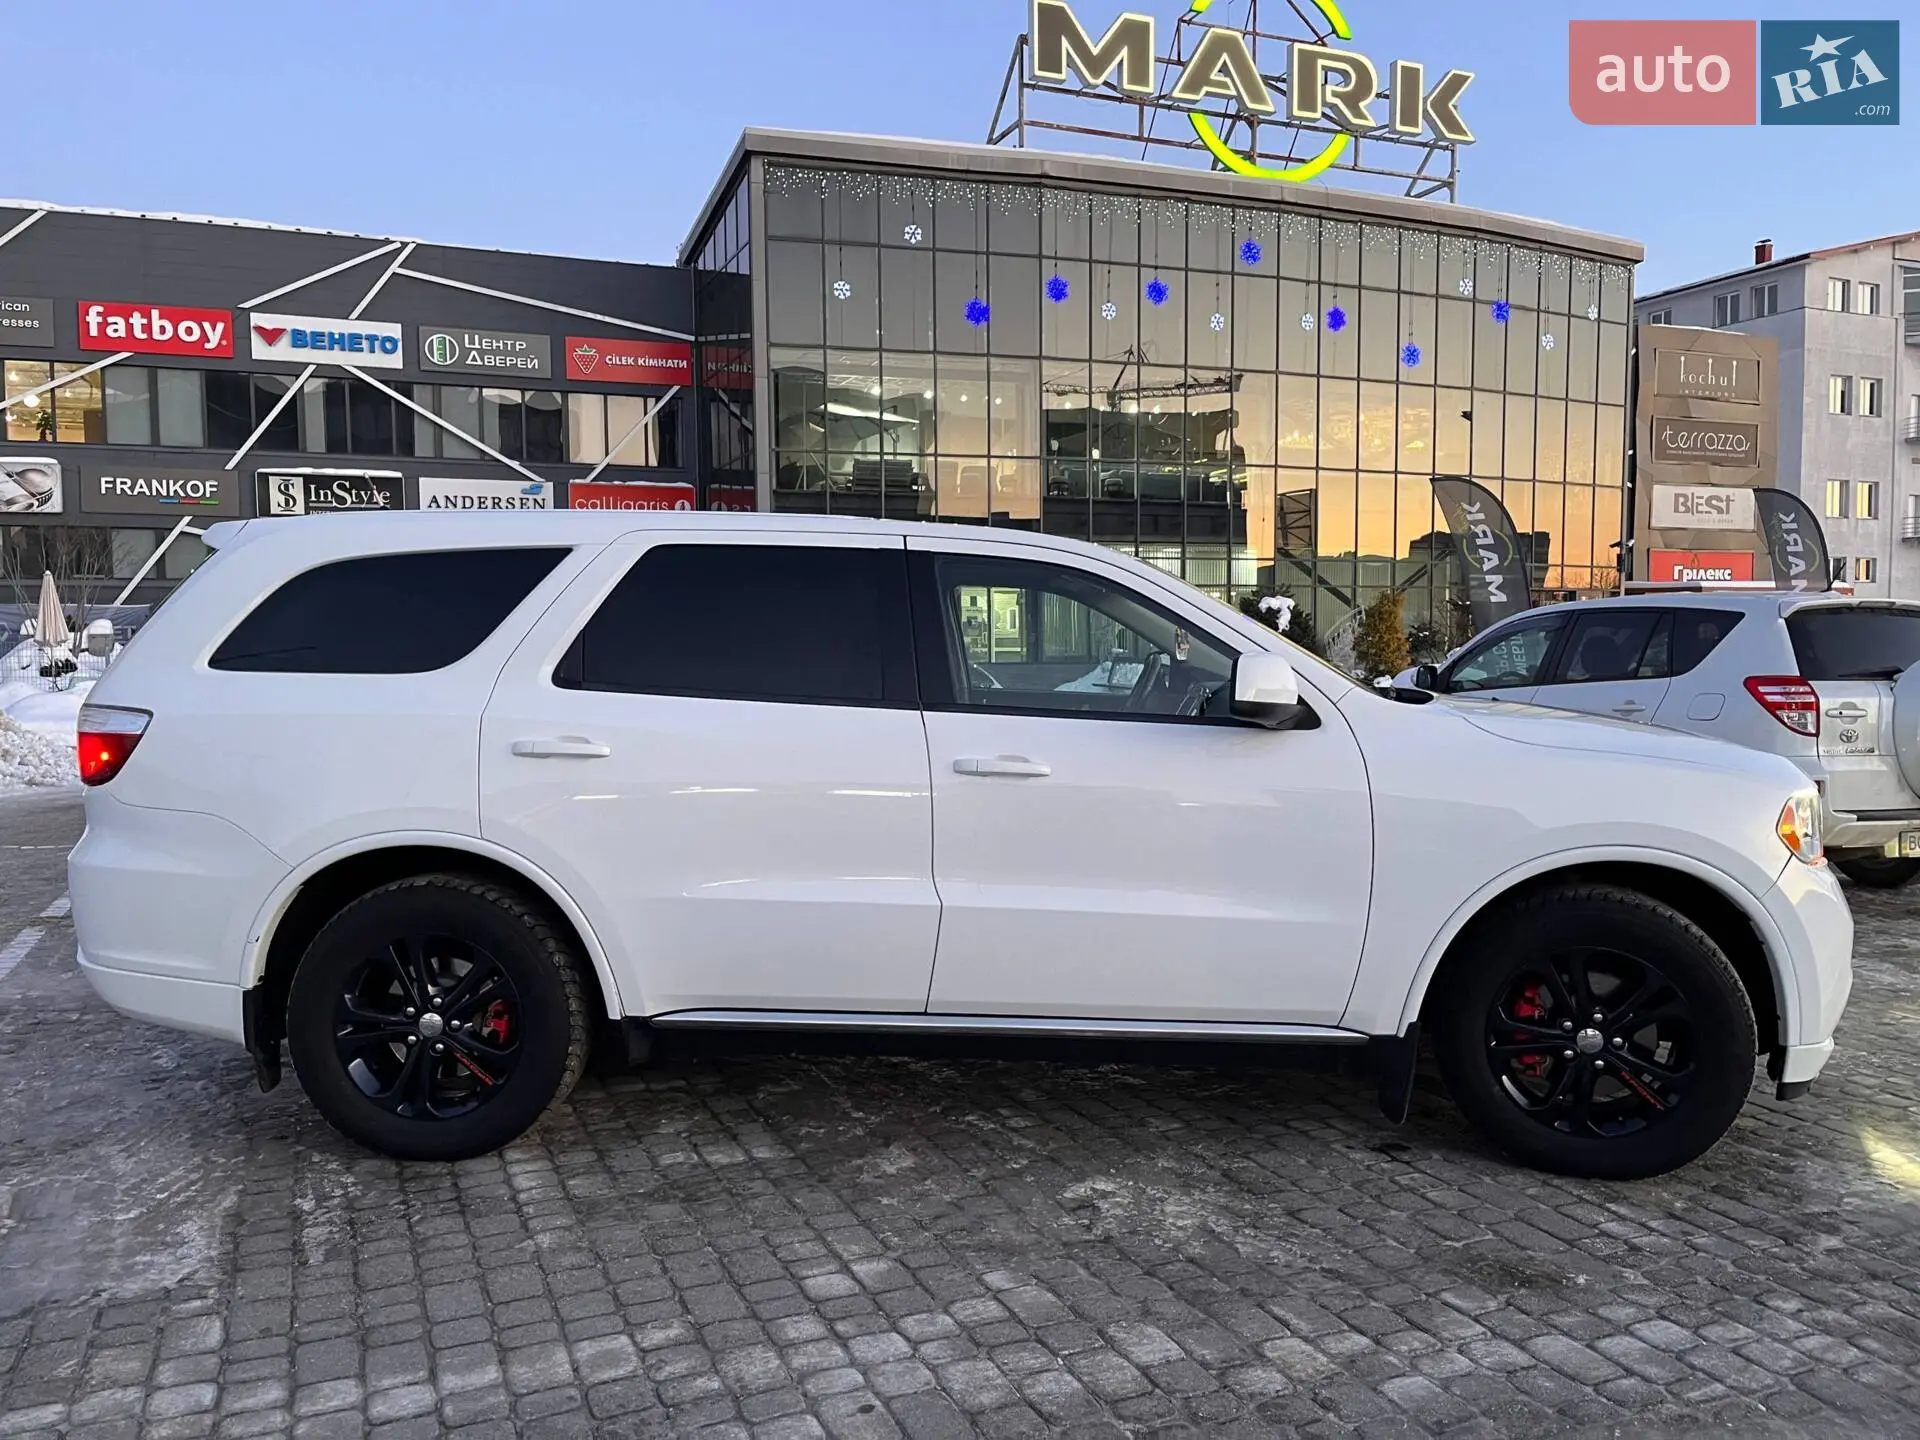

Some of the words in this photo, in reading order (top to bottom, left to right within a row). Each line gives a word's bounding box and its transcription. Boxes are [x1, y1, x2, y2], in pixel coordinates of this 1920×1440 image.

[1028, 0, 1476, 144] MARK
[0, 300, 30, 312] ican
[0, 318, 40, 329] esses
[86, 305, 226, 350] fatboy
[290, 328, 400, 355] ВЕНЕТО
[100, 476, 219, 498] FRANKOF
[428, 494, 546, 510] ANDERSEN
